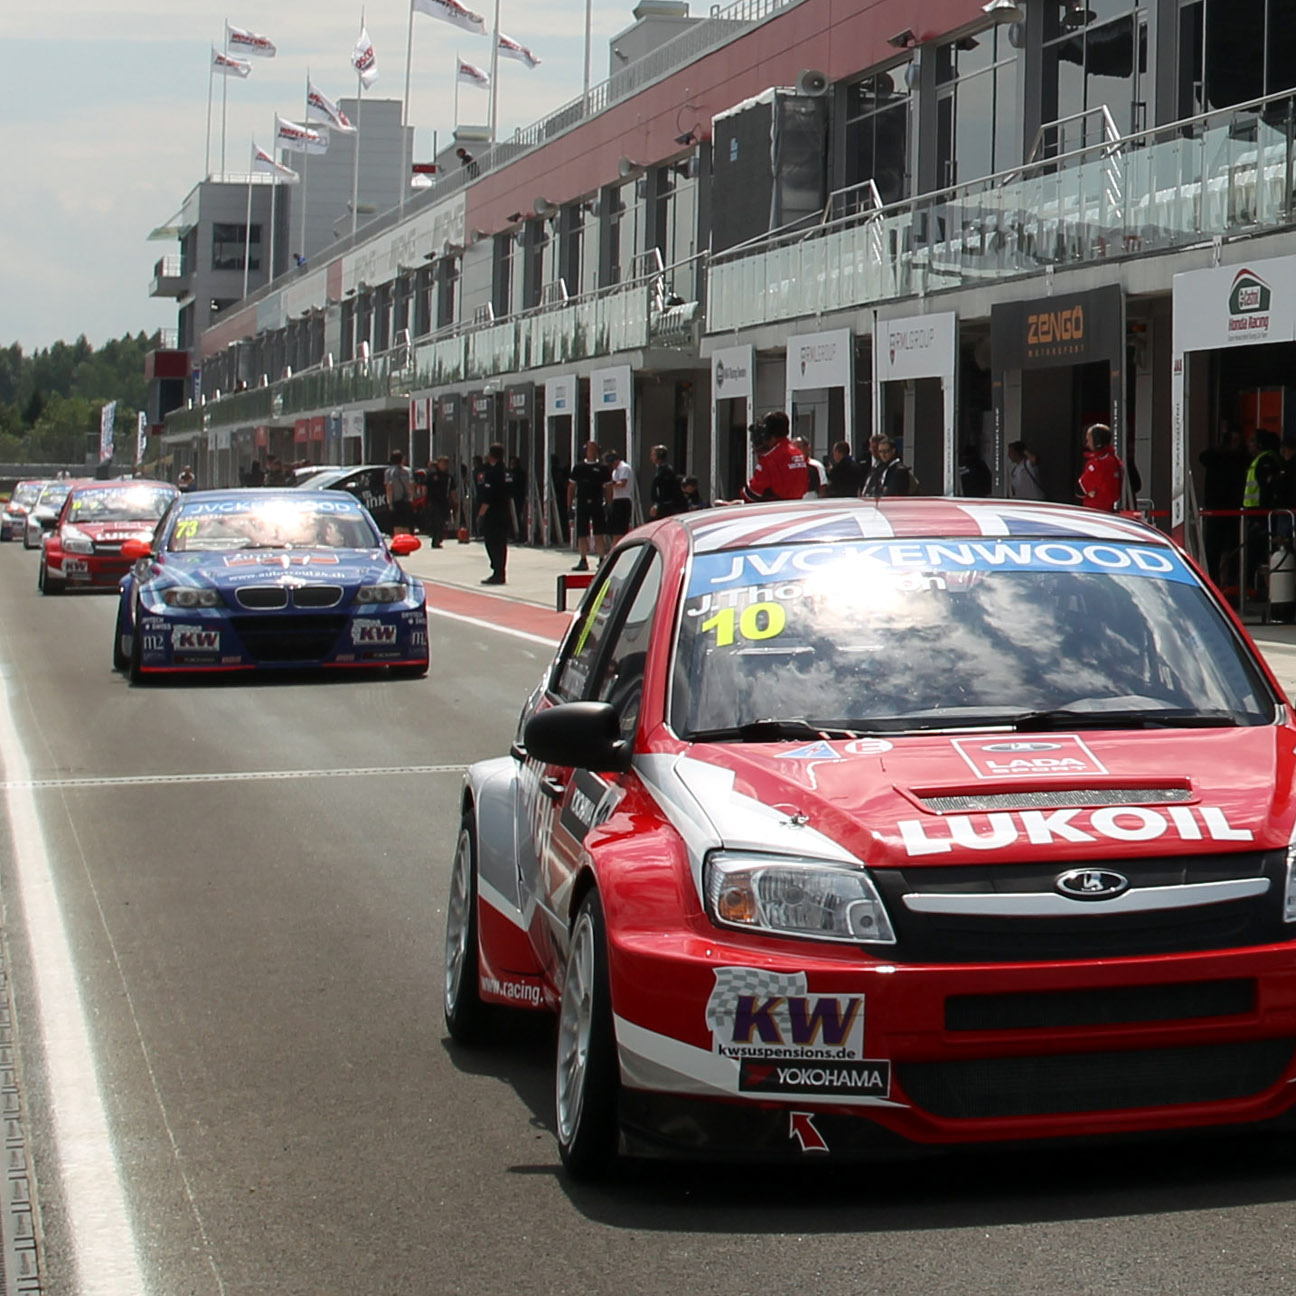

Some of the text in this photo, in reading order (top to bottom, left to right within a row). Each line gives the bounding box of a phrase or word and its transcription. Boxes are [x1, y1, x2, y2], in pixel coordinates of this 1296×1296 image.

[1228, 315, 1269, 331] Honda Racing
[175, 520, 200, 540] 73
[709, 543, 1175, 585] JVCKENWOOD
[360, 626, 395, 641] KW
[701, 601, 787, 647] 10
[180, 631, 218, 647] KW
[985, 757, 1086, 770] LADA
[991, 763, 1088, 774] SPORT
[896, 806, 1255, 857] LUKOIL
[731, 994, 864, 1047] KW
[717, 1043, 857, 1061] kwsuspensions.de
[776, 1067, 883, 1089] YOKOHAMA
